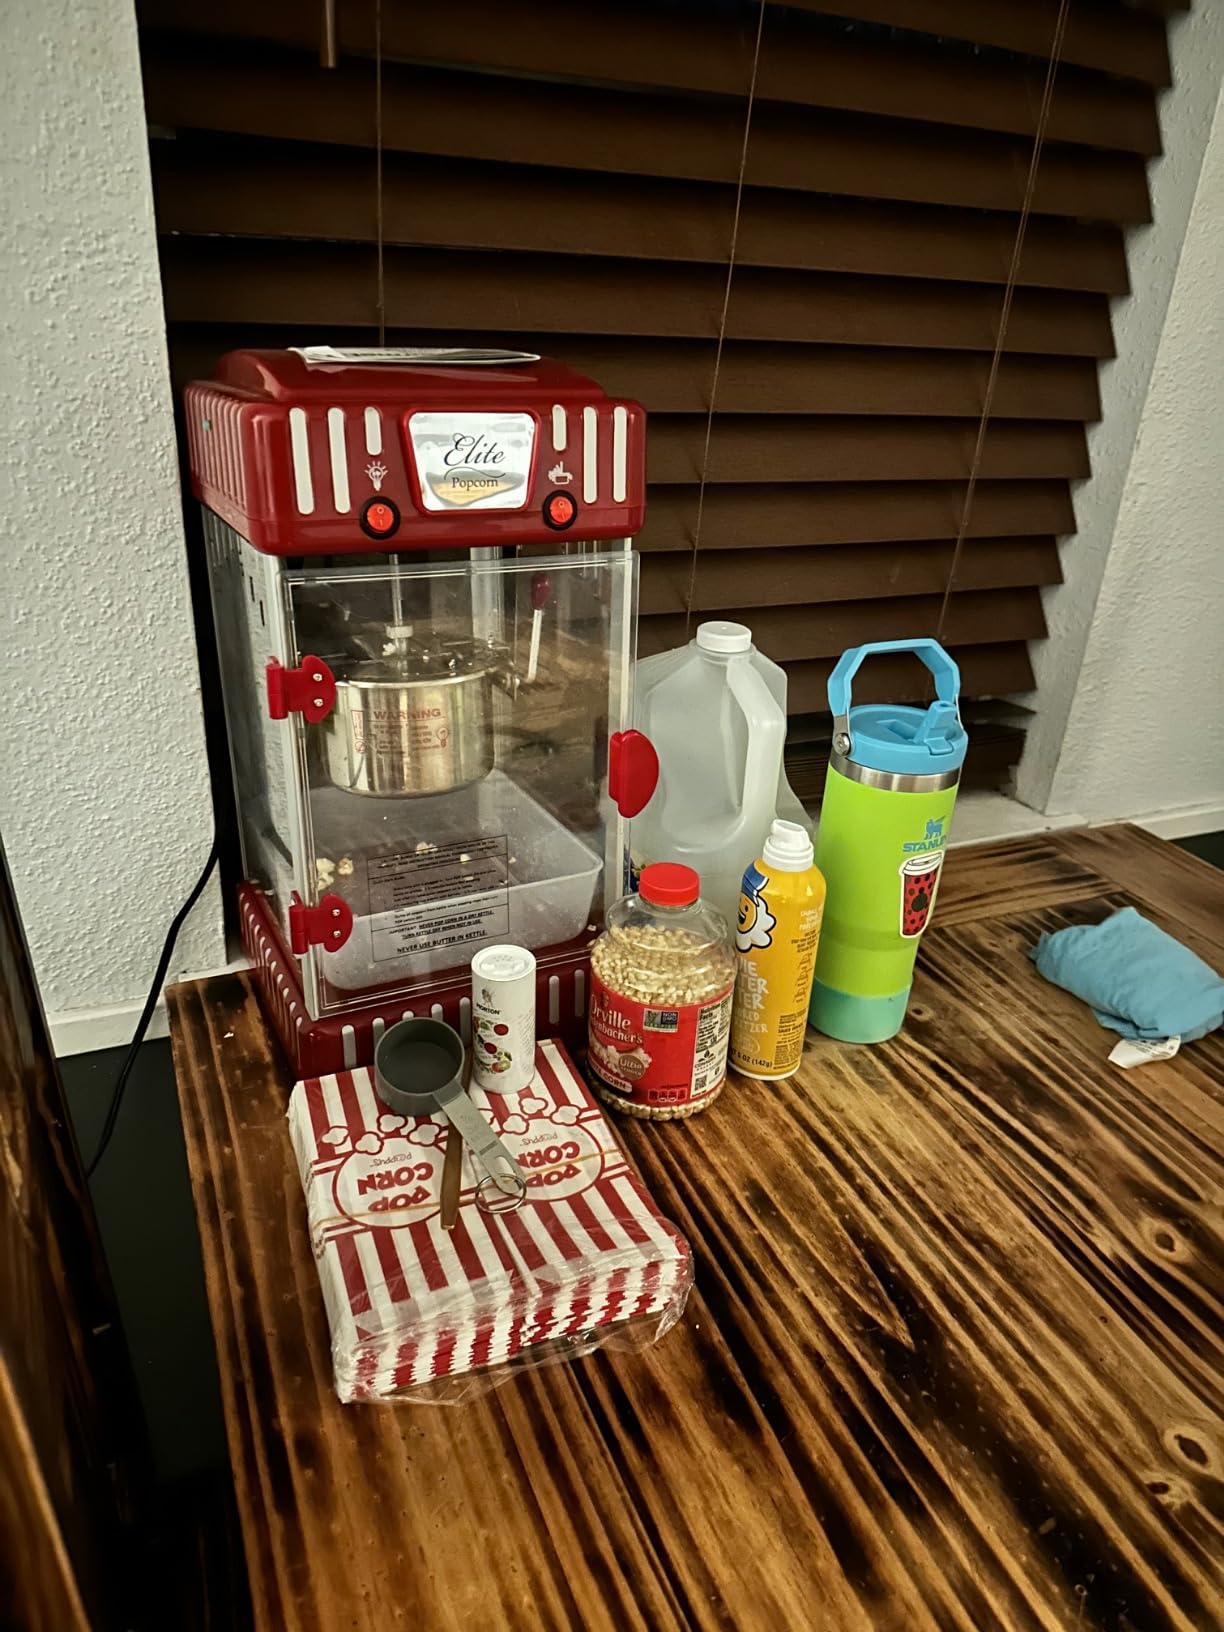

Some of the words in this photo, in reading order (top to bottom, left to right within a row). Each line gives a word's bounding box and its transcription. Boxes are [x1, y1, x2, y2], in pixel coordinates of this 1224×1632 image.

[444, 433, 506, 467] Elite
[452, 477, 498, 491] Popcorn
[374, 708, 441, 720] WARNING
[397, 944, 421, 953] NEVER
[420, 941, 431, 949] USE
[432, 936, 456, 946] BUTTER
[476, 1003, 500, 1015] MORTON
[742, 1054, 751, 1063] OZ
[751, 1058, 773, 1068] (142g)
[357, 1162, 434, 1196] CORN
[525, 1163, 582, 1188] POP
[368, 1185, 431, 1212] POP
